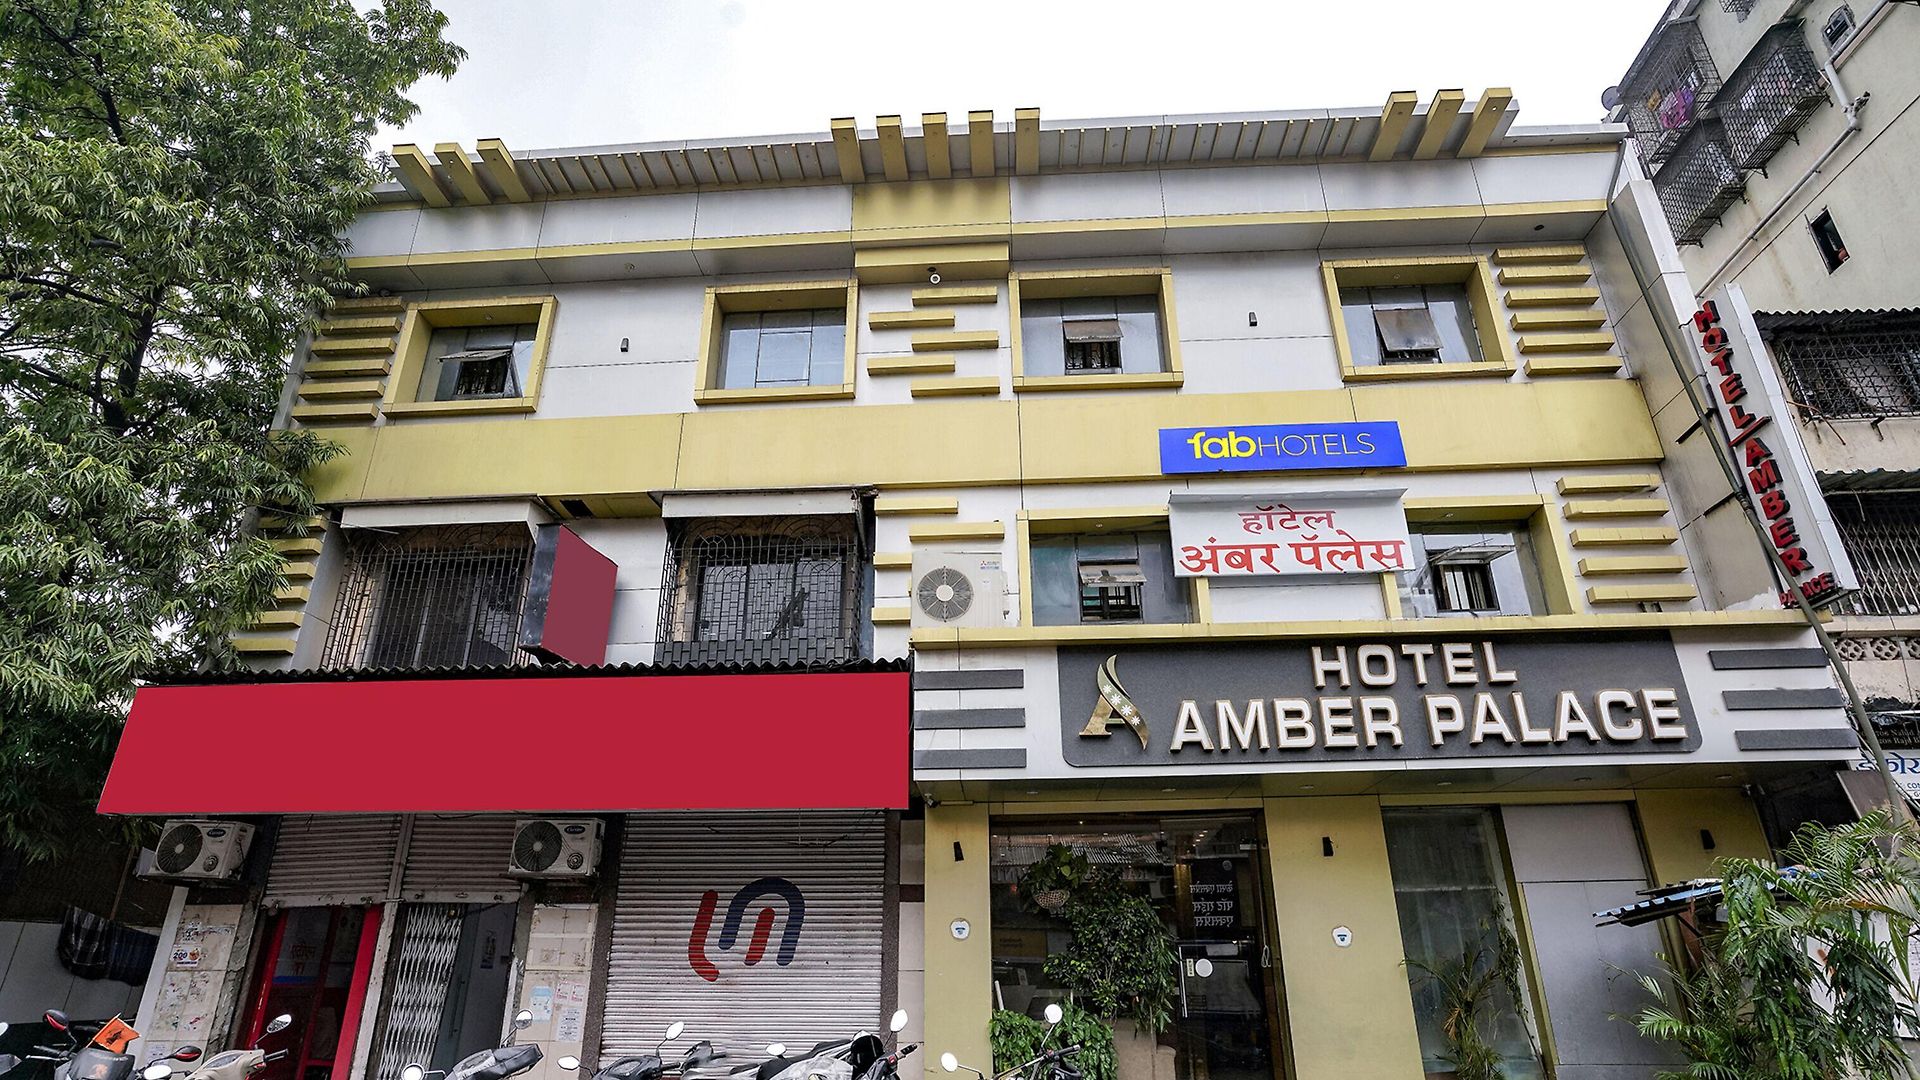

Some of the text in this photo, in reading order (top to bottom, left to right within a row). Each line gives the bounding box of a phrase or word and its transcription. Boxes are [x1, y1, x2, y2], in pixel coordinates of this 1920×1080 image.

[1187, 431, 1376, 459] fabHOTELS
[1693, 300, 1814, 577] HOTEL AMBER
[1237, 503, 1337, 535] हॉटेल
[1179, 529, 1406, 574] अंबर पॅलेस
[1780, 572, 1835, 608] PAACE
[1311, 641, 1518, 688] HOTEL
[1170, 687, 1689, 753] AMBER PALACE
